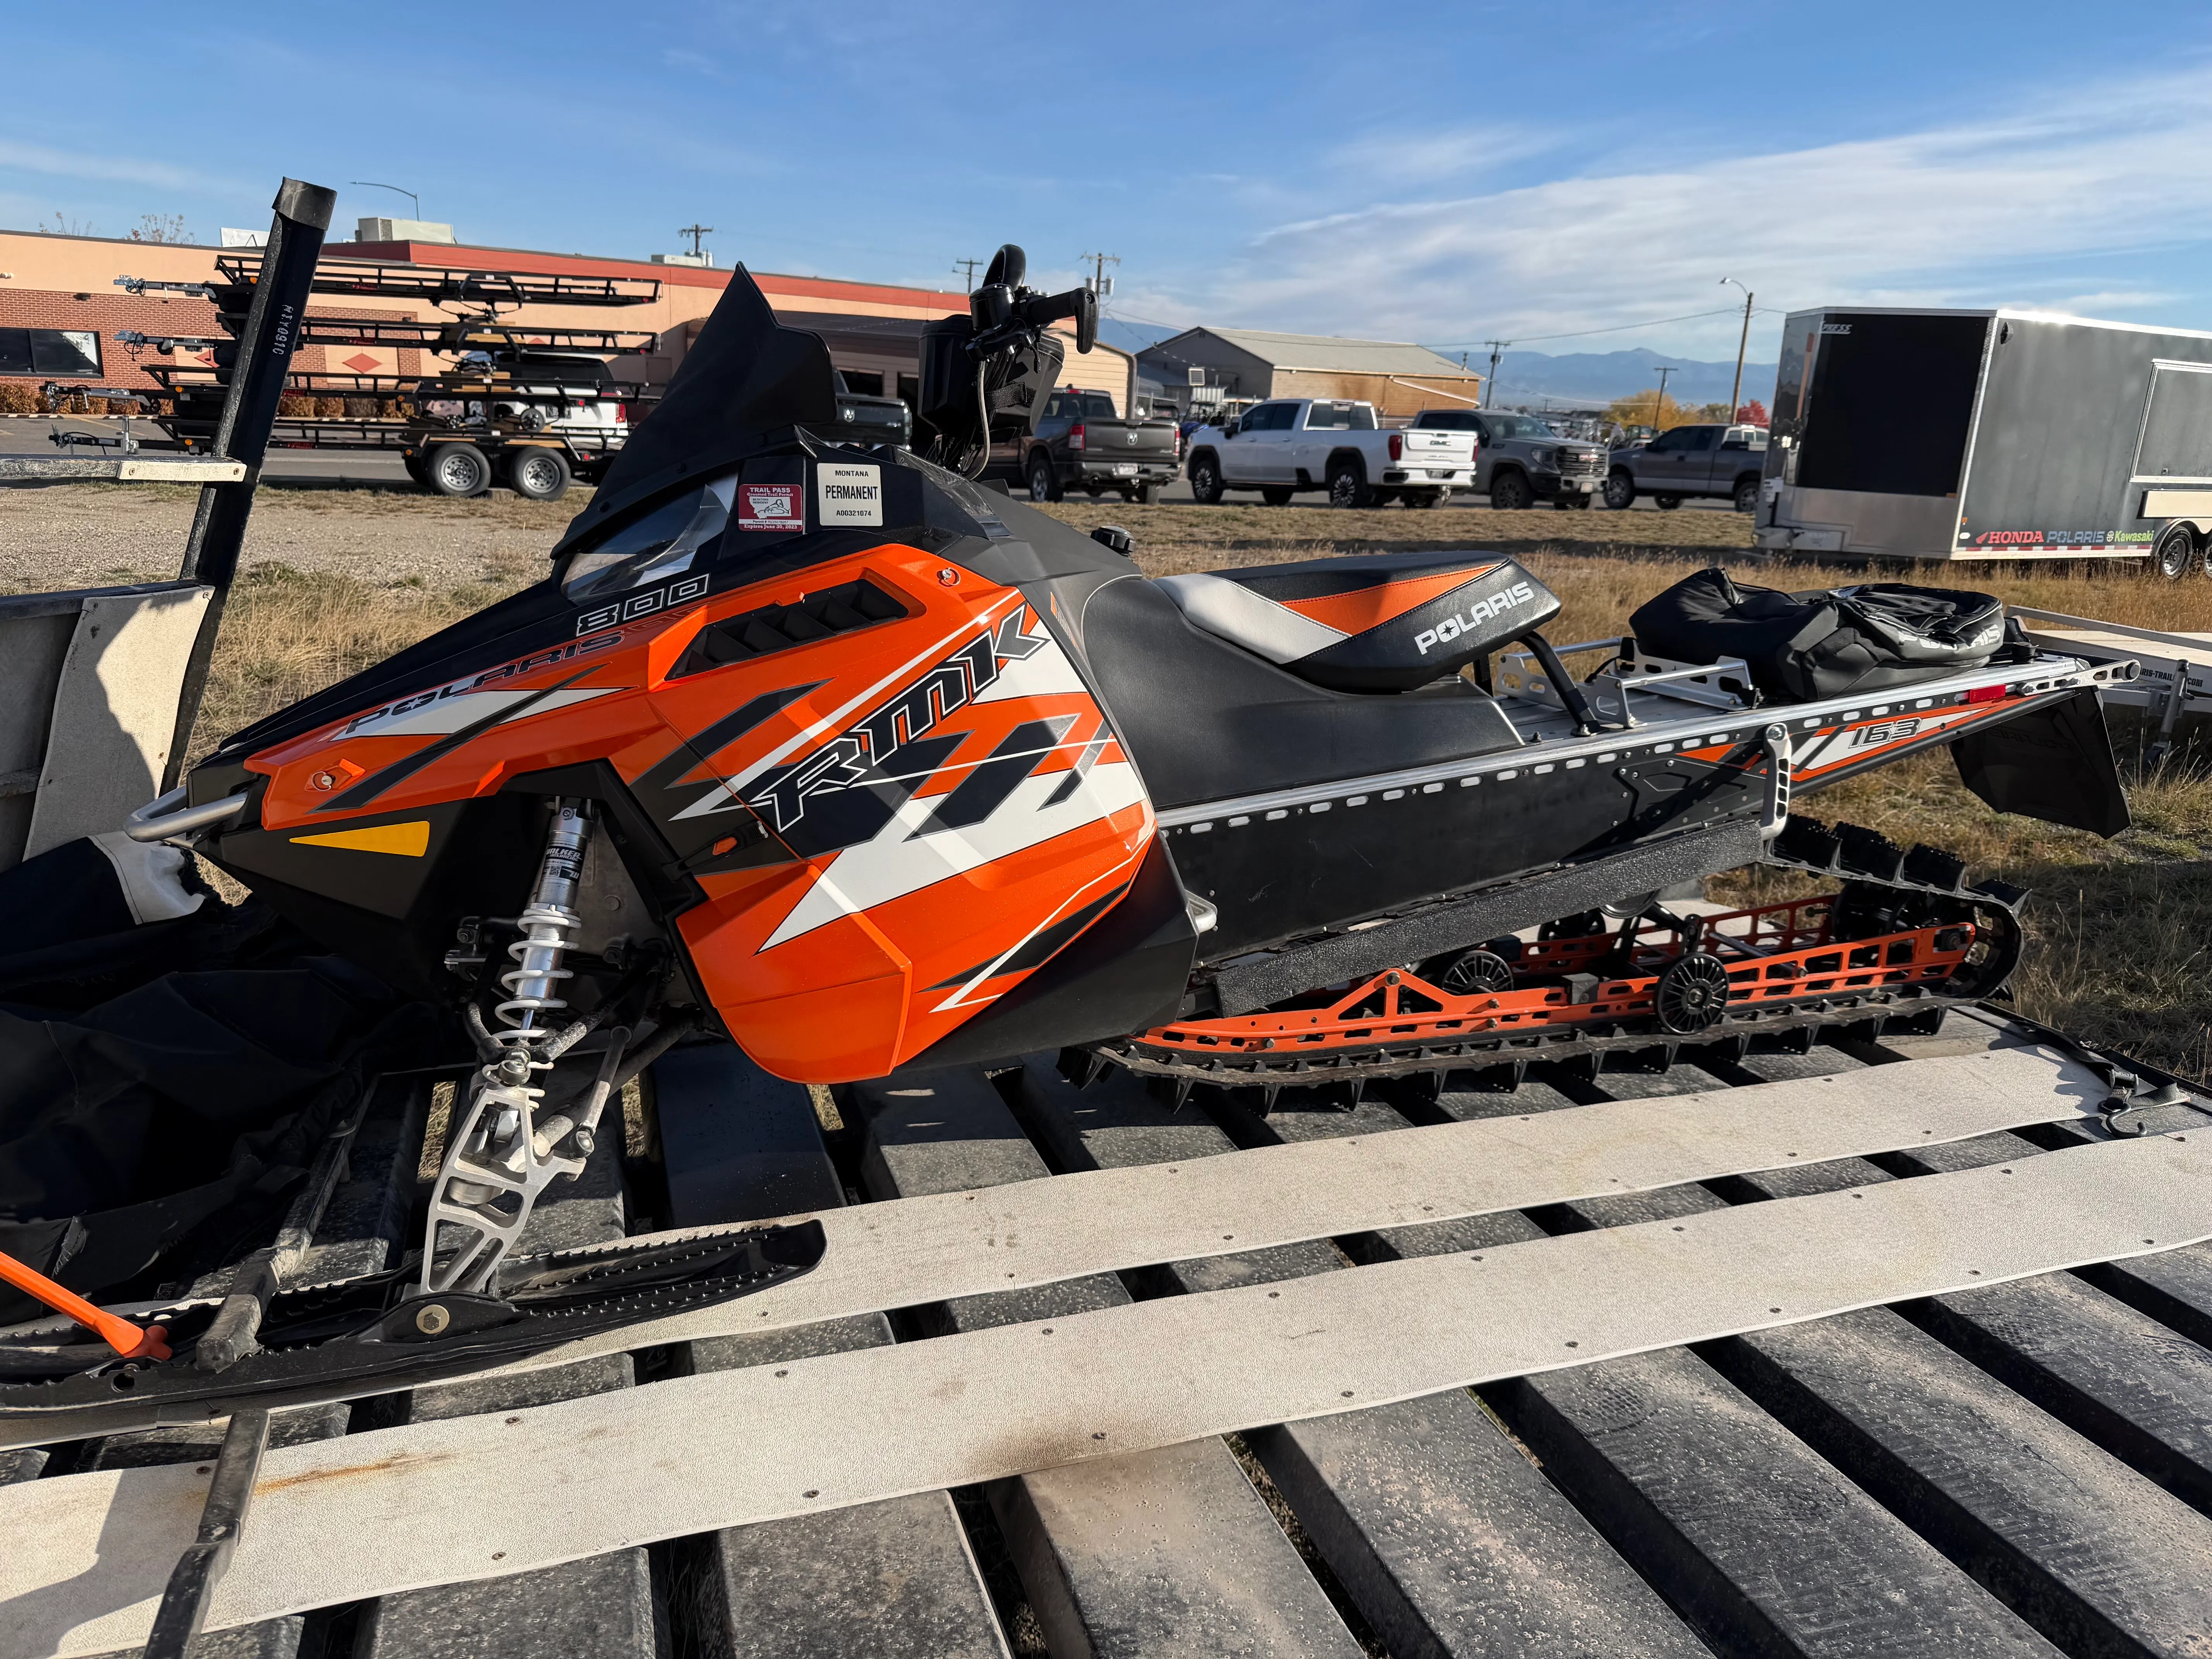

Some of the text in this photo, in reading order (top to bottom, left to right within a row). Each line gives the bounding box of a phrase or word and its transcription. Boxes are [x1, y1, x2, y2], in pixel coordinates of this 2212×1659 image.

[826, 485, 878, 500] PERMANENT
[1988, 531, 2044, 544] HONDA
[2047, 531, 2105, 543] POLARIS
[2114, 530, 2154, 542] Kawasaki
[576, 573, 711, 637] 800
[1414, 581, 1535, 655] POLARIS
[345, 630, 625, 735] POLARIS
[749, 601, 1051, 833] RMK
[1848, 717, 1923, 749] 163
